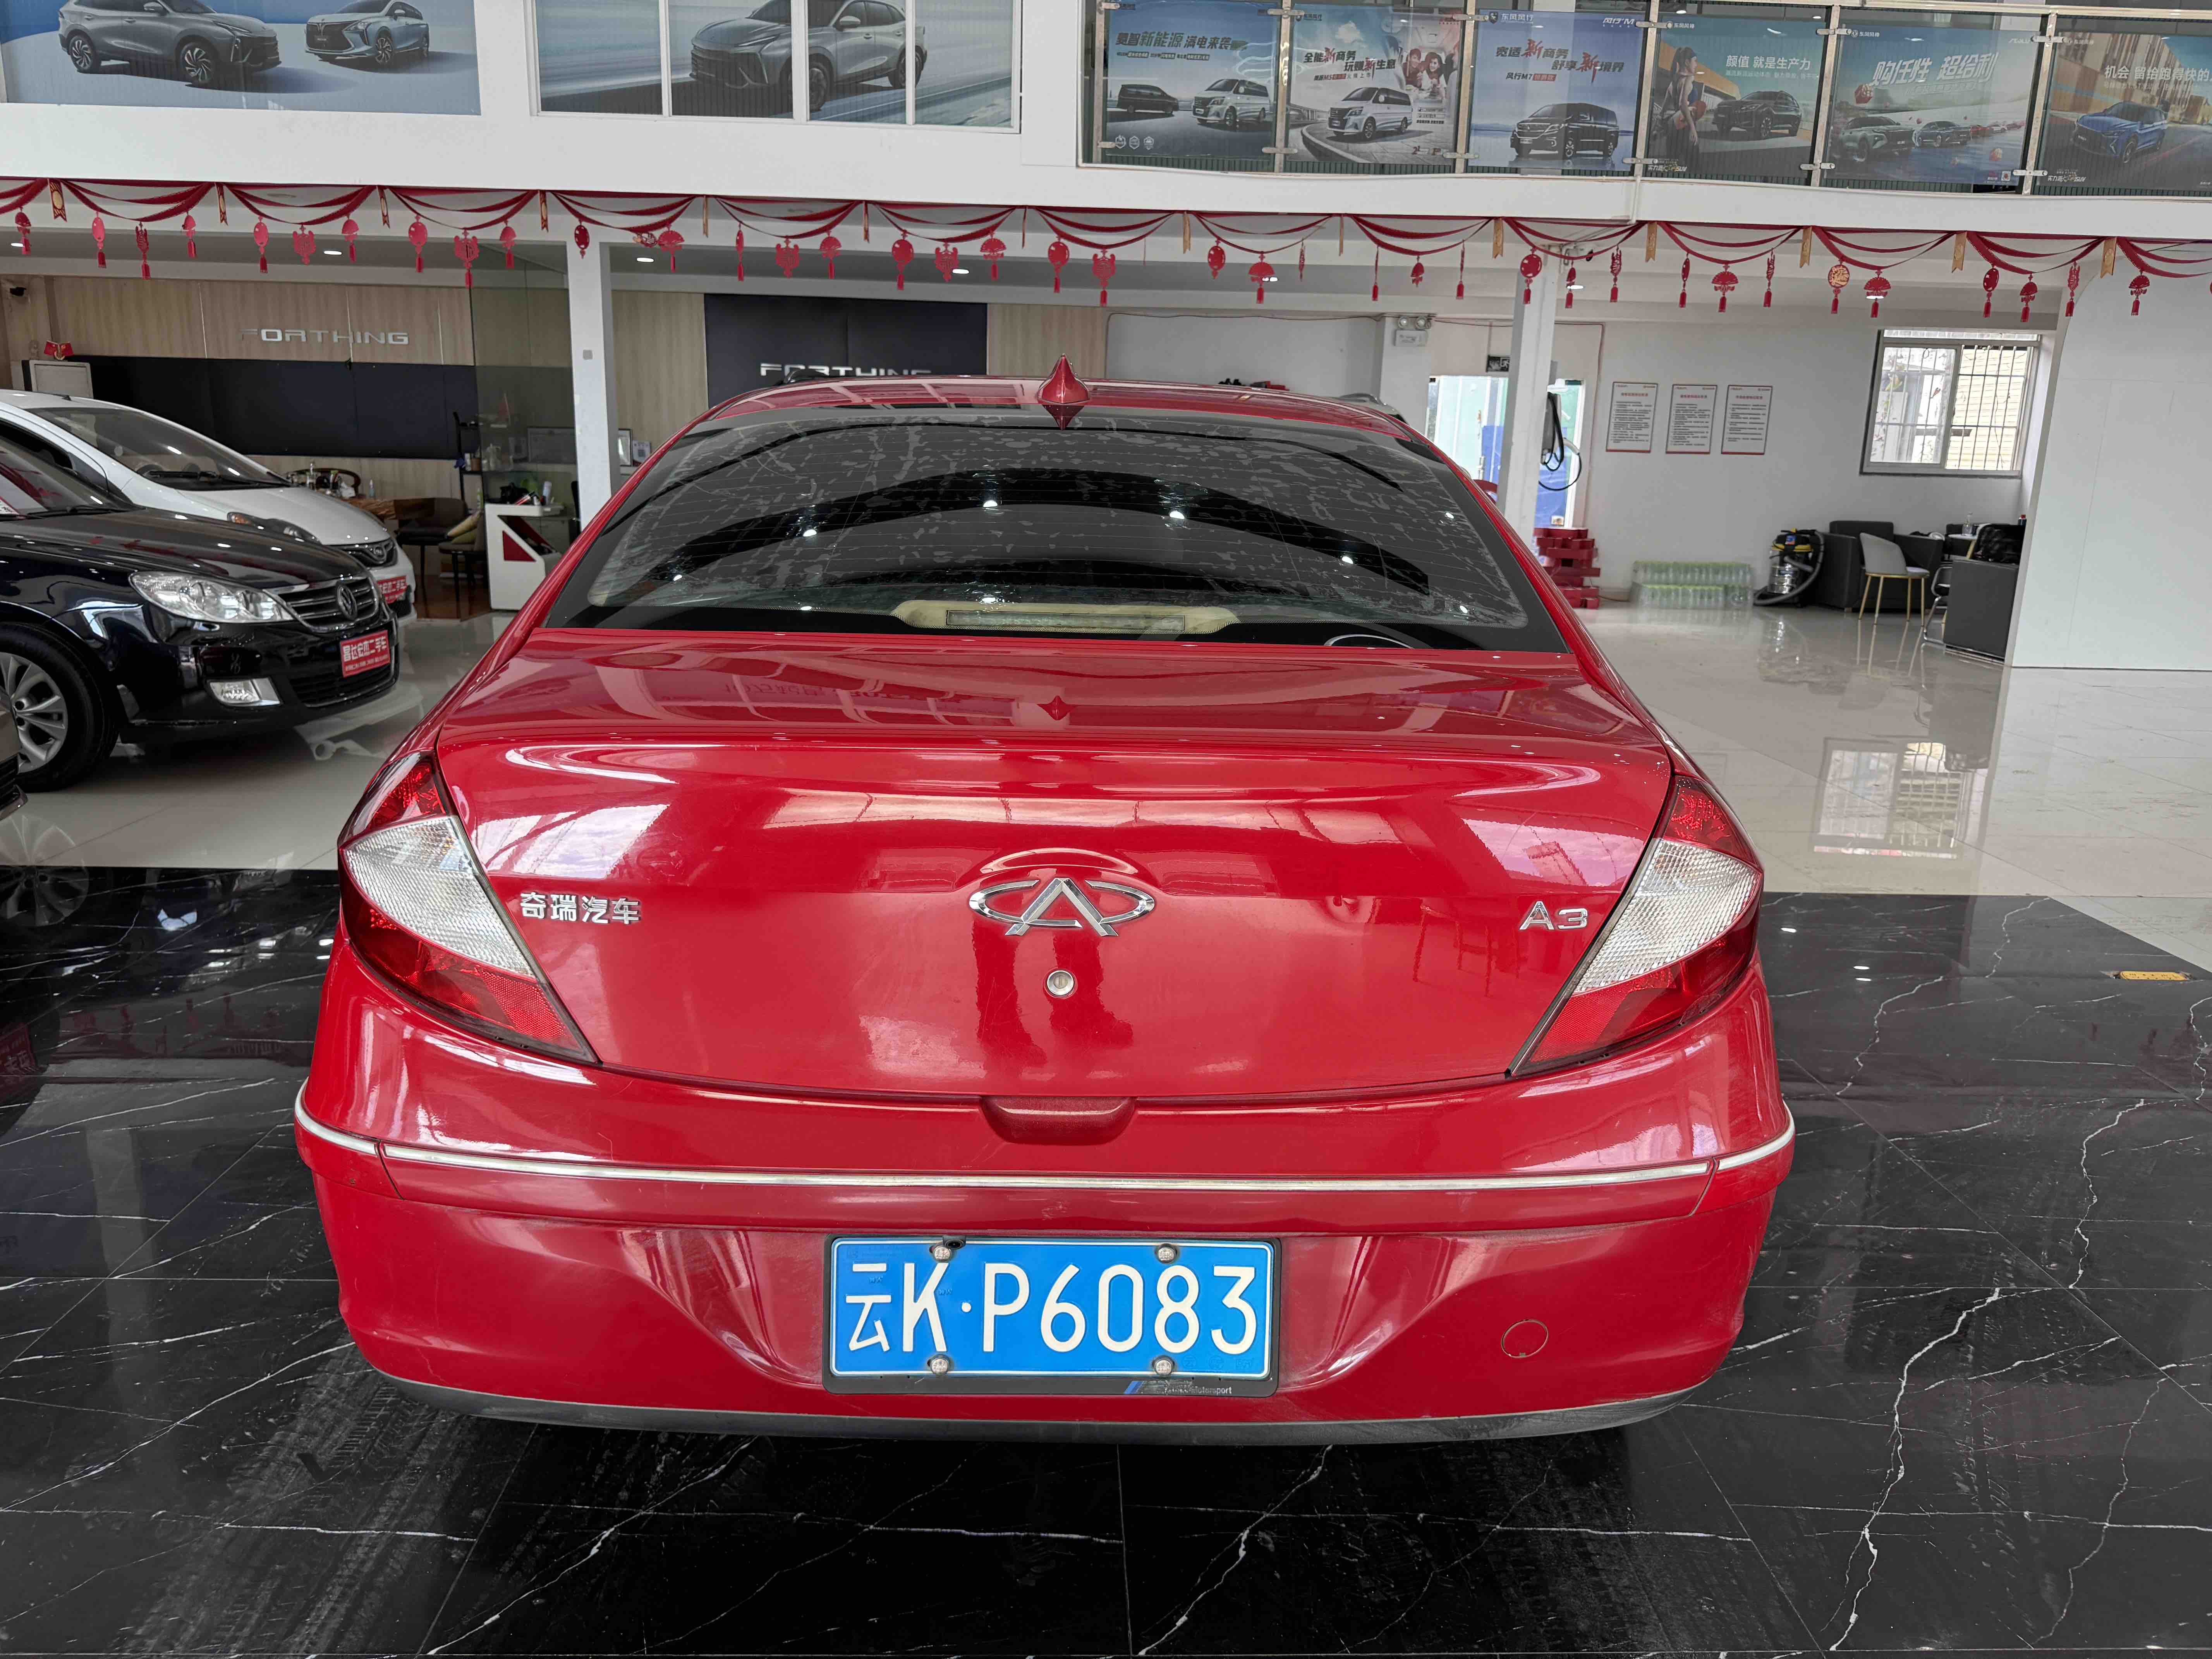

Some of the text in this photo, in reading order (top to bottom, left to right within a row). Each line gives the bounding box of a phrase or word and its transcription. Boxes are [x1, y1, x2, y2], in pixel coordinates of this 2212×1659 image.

[1304, 47, 1357, 64] 全能新商务
[1496, 39, 1569, 59] 宽适新商务
[1551, 52, 1625, 84] 舒享新境界
[1726, 55, 1811, 71] 颜值 就是生产力
[1870, 57, 1933, 85] 购任性
[2104, 65, 2212, 82] 机会 留给跑得快的
[240, 328, 409, 345] FORTHING
[520, 892, 639, 925] 奇瑞汽车
[1519, 901, 1588, 930] A3
[845, 1261, 1257, 1354] 云K·P6083
